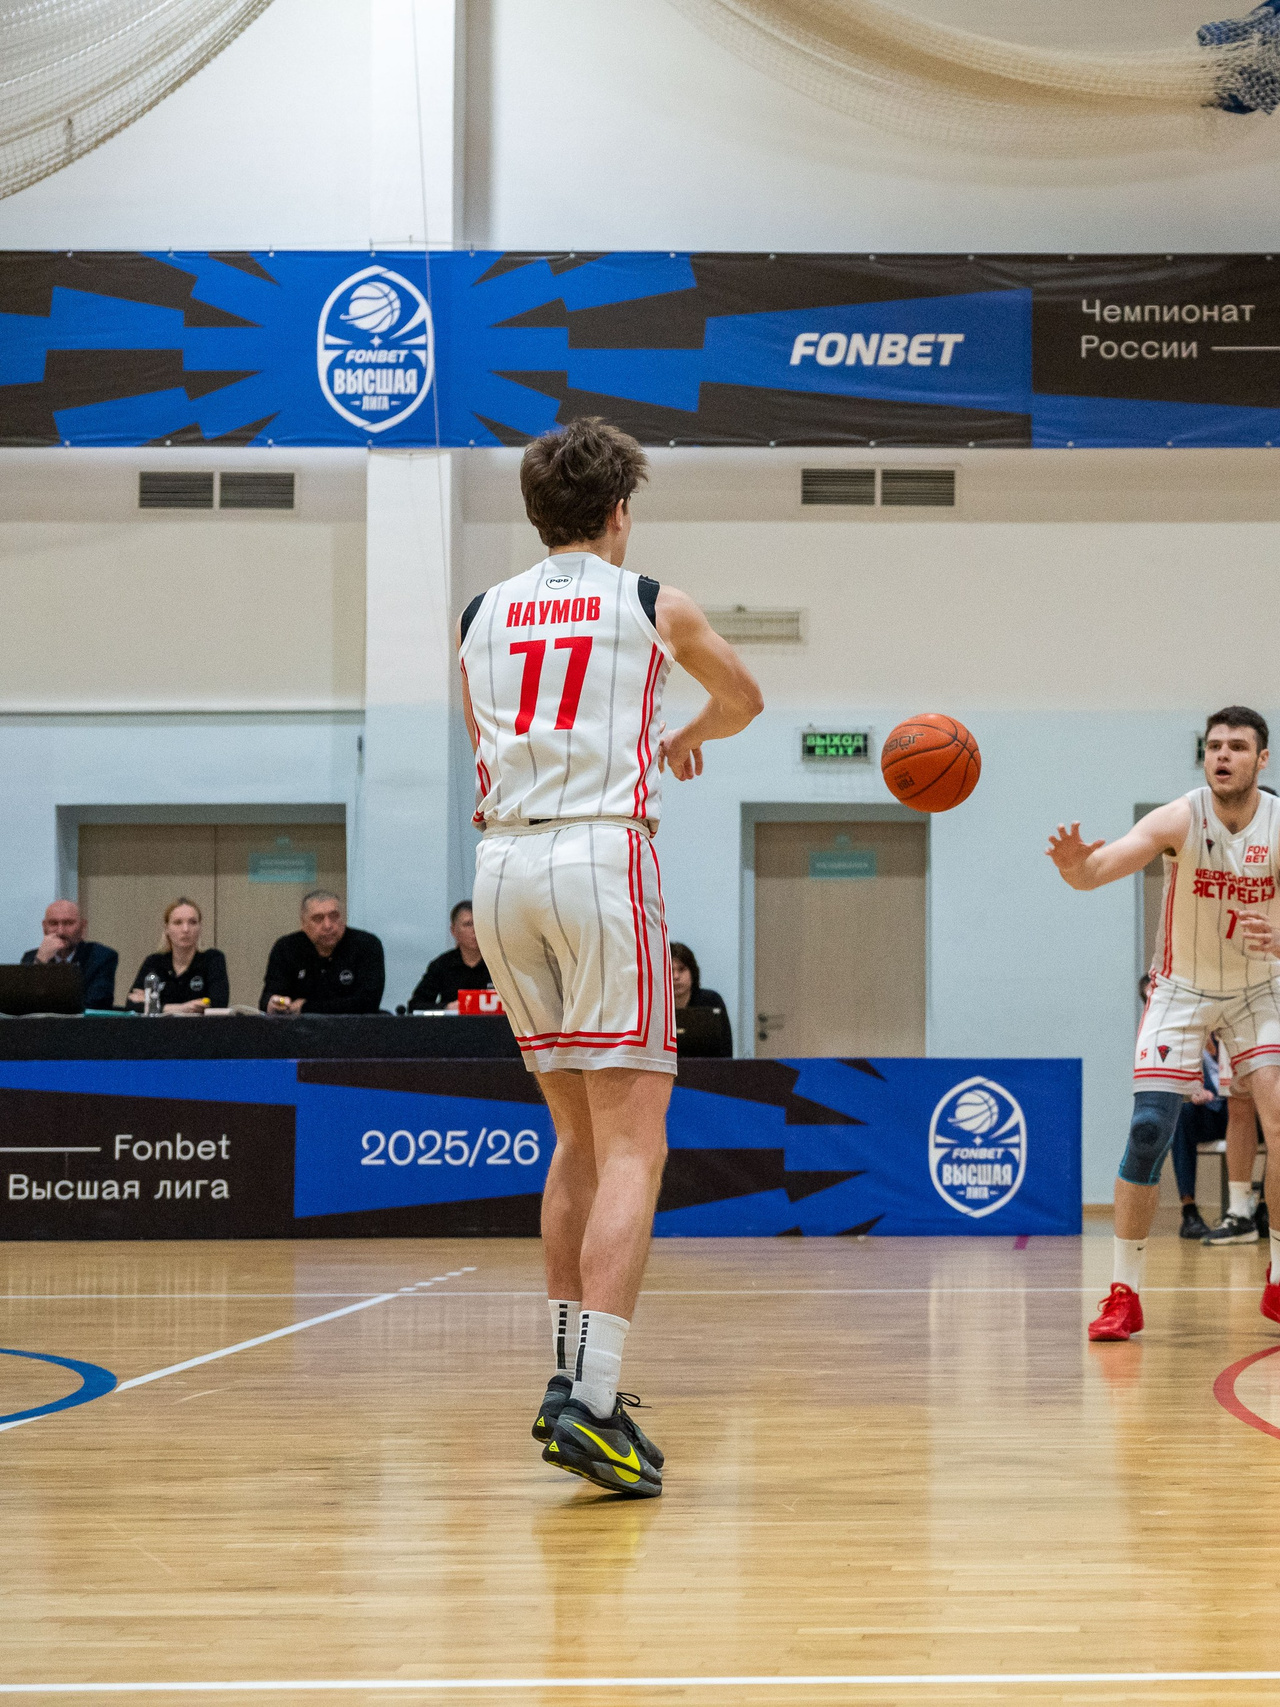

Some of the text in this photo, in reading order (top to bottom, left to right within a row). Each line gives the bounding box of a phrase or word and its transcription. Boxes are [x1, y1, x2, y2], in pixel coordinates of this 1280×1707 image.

[1081, 299, 1256, 323] Чемпионат
[344, 349, 409, 363] FONBET
[789, 332, 965, 366] FONBET
[1080, 334, 1198, 359] России
[333, 368, 418, 395] ВЫСШАЯ
[361, 395, 390, 411] ЛИГА
[505, 596, 602, 628] НАУМОВ
[509, 636, 594, 736] 77
[806, 733, 864, 747] ВЫХОД
[814, 746, 855, 756] EXIT
[1244, 854, 1267, 864] BET
[1247, 845, 1269, 855] FON
[1192, 880, 1276, 905] ЯСТРЕБЫ
[114, 1132, 231, 1161] Fonbet
[361, 1127, 540, 1168] 2025/26
[952, 1147, 1005, 1160] FONBET
[942, 1163, 1013, 1186] ВЫСШАЯ
[8, 1174, 230, 1200] Высшая лига
